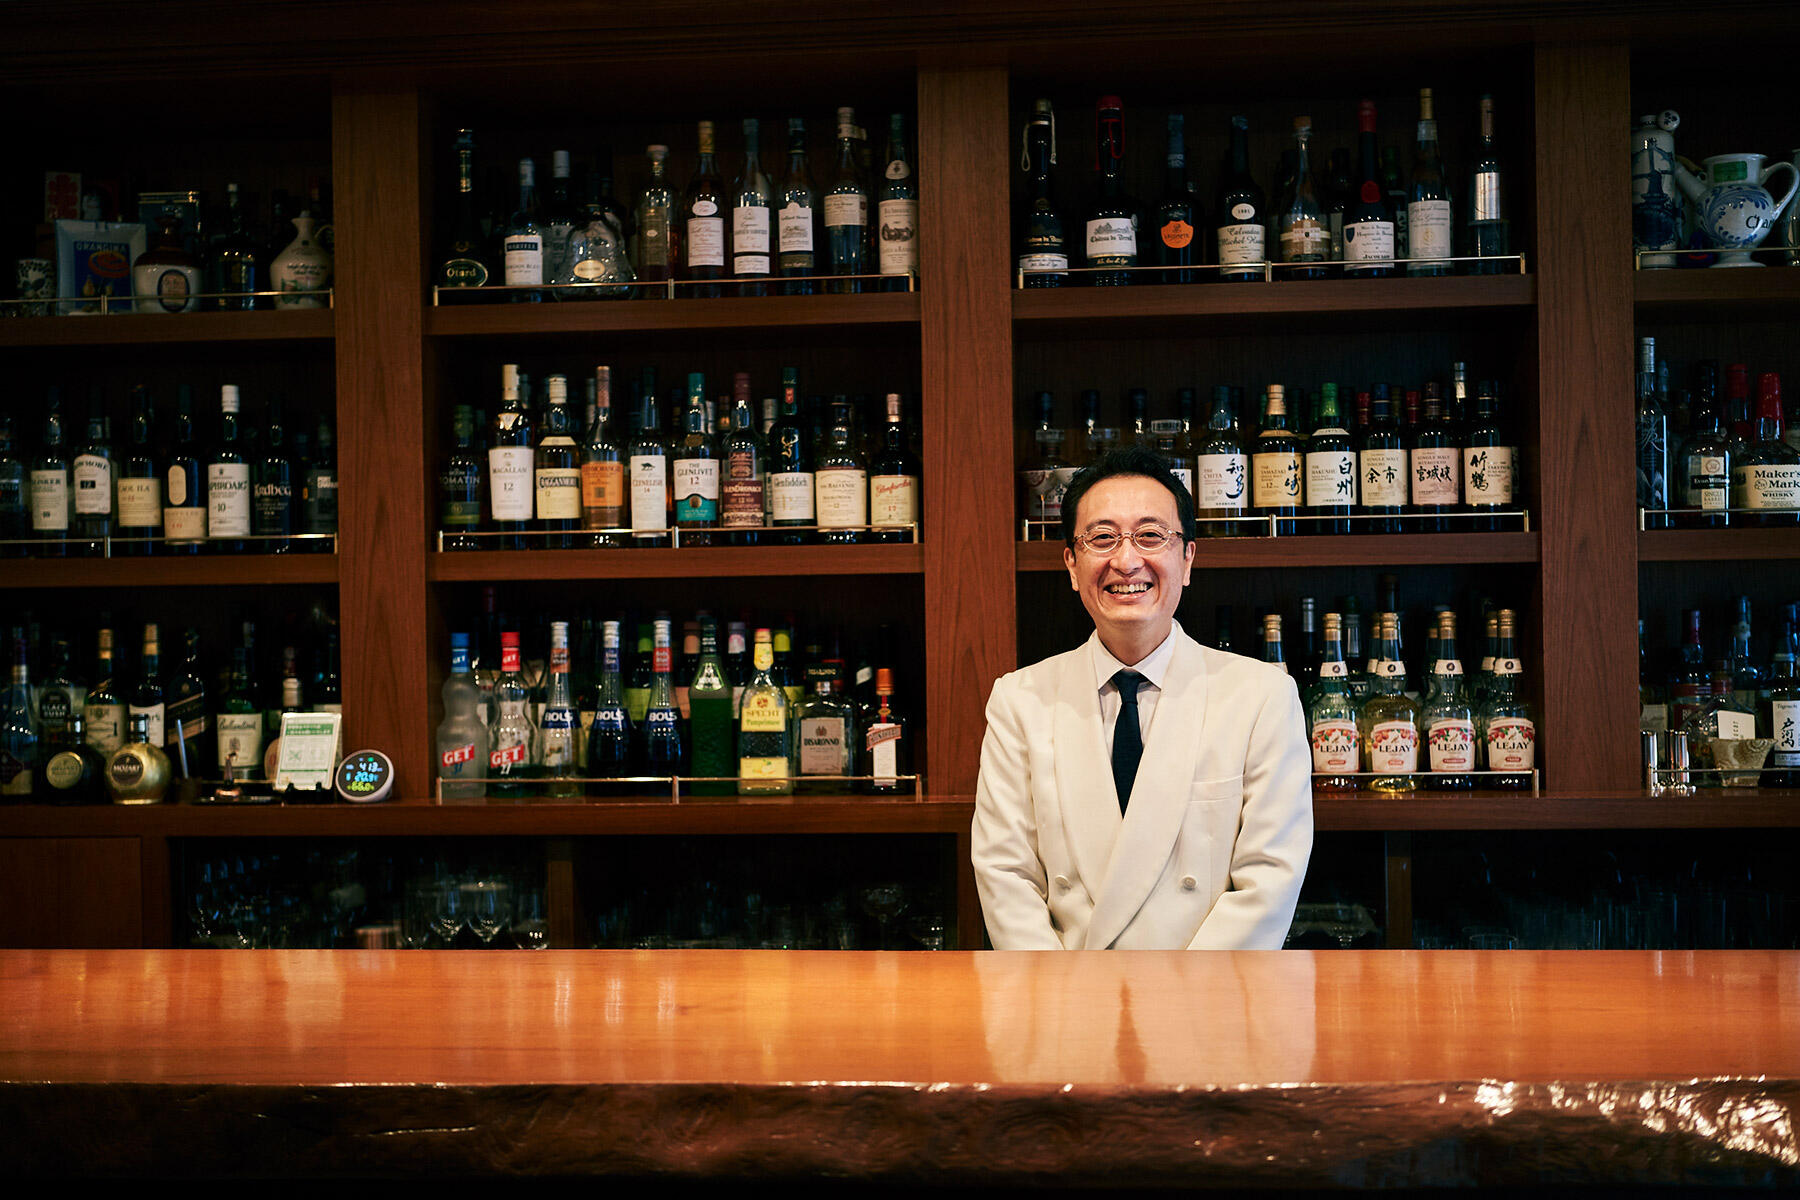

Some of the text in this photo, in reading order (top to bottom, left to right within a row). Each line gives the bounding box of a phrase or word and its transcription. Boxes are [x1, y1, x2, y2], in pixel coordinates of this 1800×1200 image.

[446, 267, 477, 278] Otard
[691, 476, 700, 486] 12
[1337, 457, 1353, 499] 白州
[504, 482, 514, 492] 12
[1769, 480, 1800, 489] Mark
[545, 712, 574, 722] BOLS
[596, 711, 625, 721] BOLS
[648, 711, 678, 721] BOLS
[803, 737, 840, 746] DISARONNO
[1496, 742, 1529, 751] LEJAY
[1320, 743, 1352, 753] LEJAY
[1378, 743, 1411, 753] LEJAY
[1437, 743, 1470, 752] LEJAY
[443, 745, 473, 765] GET
[490, 745, 522, 765] GET
